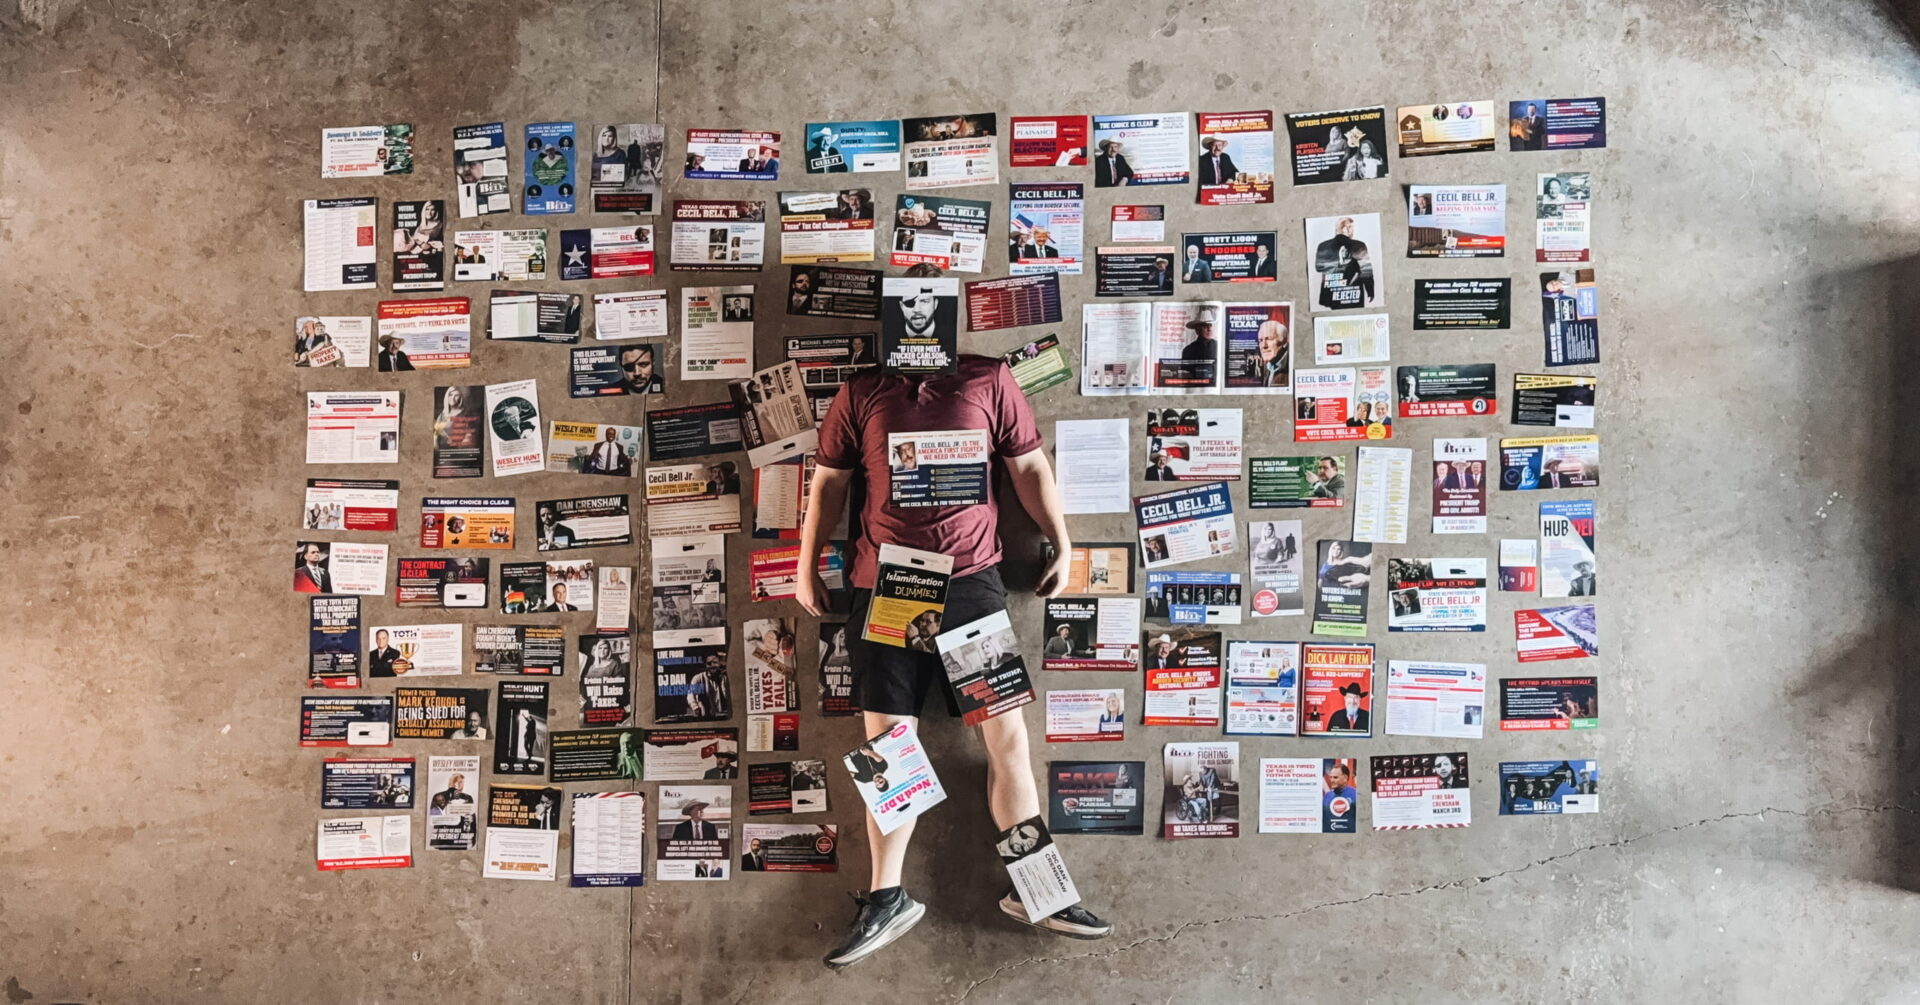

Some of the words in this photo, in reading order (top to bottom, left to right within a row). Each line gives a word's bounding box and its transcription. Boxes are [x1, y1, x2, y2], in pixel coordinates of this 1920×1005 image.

[1295, 120, 1320, 128] VOTERS
[1321, 117, 1349, 125] DESERVE
[1360, 112, 1381, 121] KNOW
[815, 158, 840, 166] GUILTY
[1015, 190, 1041, 198] CECIL
[1043, 190, 1066, 199] BELL,
[1067, 190, 1080, 198] JR.
[1436, 192, 1459, 201] CECIL
[1462, 192, 1482, 201] BELL
[677, 210, 701, 218] CECIL
[703, 210, 724, 219] BELL,
[726, 210, 739, 218] JR.
[938, 207, 956, 215] CECIL
[975, 210, 986, 218] JR.
[1204, 247, 1255, 255] ENDORSES
[819, 272, 833, 280] DAN
[834, 272, 876, 283] CRENSHAW'S
[1332, 289, 1360, 301] REJECTED
[310, 346, 337, 360] PROPERTY
[316, 354, 335, 365] TAXES
[555, 425, 578, 434] WESLEY
[580, 426, 596, 435] HUNT
[496, 457, 521, 466] WESLEY
[523, 454, 540, 462] HUNT
[648, 473, 666, 483] Cecil
[668, 472, 683, 482] Bell
[684, 472, 695, 481] Jr.
[556, 501, 575, 511] DAN
[576, 497, 621, 509] CRENSHAW
[1141, 502, 1175, 519] CECIL
[1176, 497, 1203, 512] BELL
[1207, 493, 1225, 508] JR.
[1544, 520, 1568, 537] HUB
[401, 561, 414, 569] THE
[415, 561, 446, 570] CONTRAST
[407, 569, 430, 578] CLEAR.
[886, 572, 944, 587] Islamification
[894, 586, 938, 599] DUMMIES
[1322, 587, 1339, 595] VOTERS
[1339, 588, 1361, 596] DESERVE
[1422, 597, 1444, 606] CECIL
[1447, 596, 1467, 605] BELL
[393, 630, 418, 638] TOTH
[476, 627, 487, 635] DAN
[488, 627, 515, 635] CRENSHAW
[476, 635, 496, 643] FOUGHT
[476, 642, 495, 650] BORDER
[497, 642, 523, 650] CALAMITY.
[670, 650, 684, 658] FROM
[1308, 653, 1328, 663] DICK
[1329, 654, 1347, 664] LAW
[1349, 654, 1369, 665] FIRM
[658, 675, 668, 686] DJ
[669, 673, 686, 685] DAN
[523, 685, 544, 693] HUNT
[587, 686, 601, 696] Will
[603, 685, 623, 696] Raise
[763, 671, 773, 710] TAXES
[774, 678, 786, 708] FALL
[398, 697, 423, 707] MARK
[425, 697, 458, 707] KEOUGH
[591, 696, 619, 707] Taxes.
[397, 708, 424, 720] BEING
[425, 707, 448, 720] SUED
[450, 706, 466, 719] FOR
[397, 720, 426, 729] SEXUALLY
[427, 720, 465, 729] ASSAULTING
[1198, 751, 1228, 759] FIGHTING
[905, 779, 931, 800] Need
[1044, 853, 1067, 893] CRENSHAW
[1057, 863, 1068, 882] DAN"
